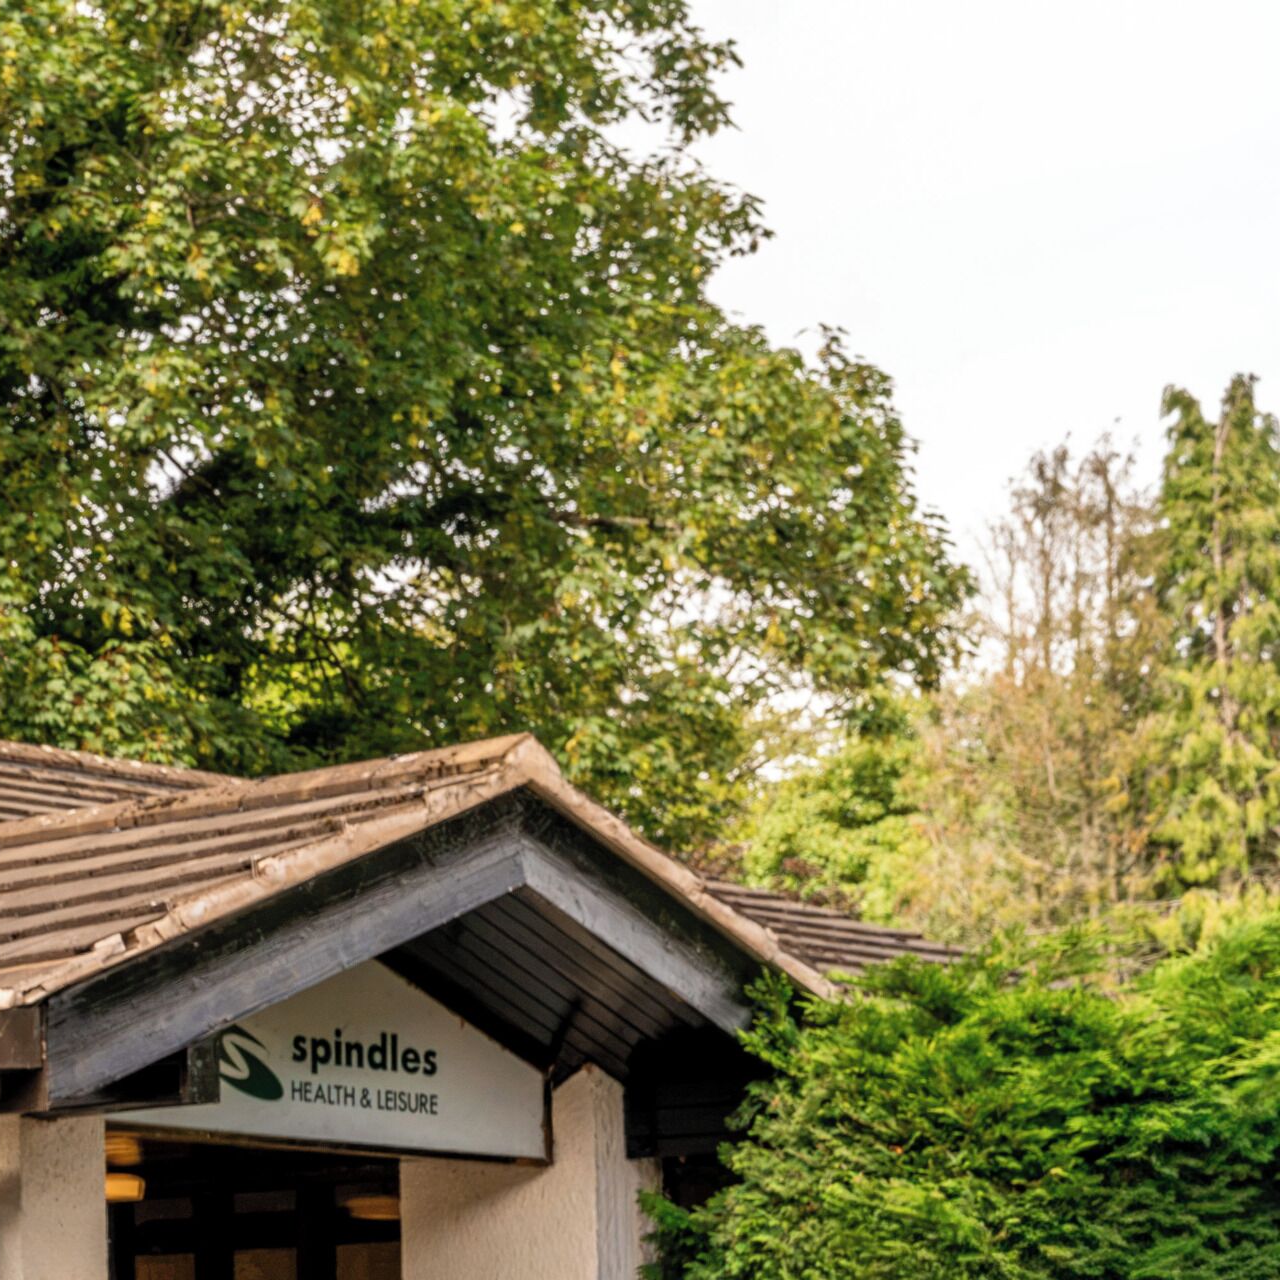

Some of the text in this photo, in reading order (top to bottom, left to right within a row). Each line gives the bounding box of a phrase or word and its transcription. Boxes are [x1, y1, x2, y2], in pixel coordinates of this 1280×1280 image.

[291, 1028, 438, 1077] spindles
[290, 1080, 439, 1116] HEALTH & LEISURE
